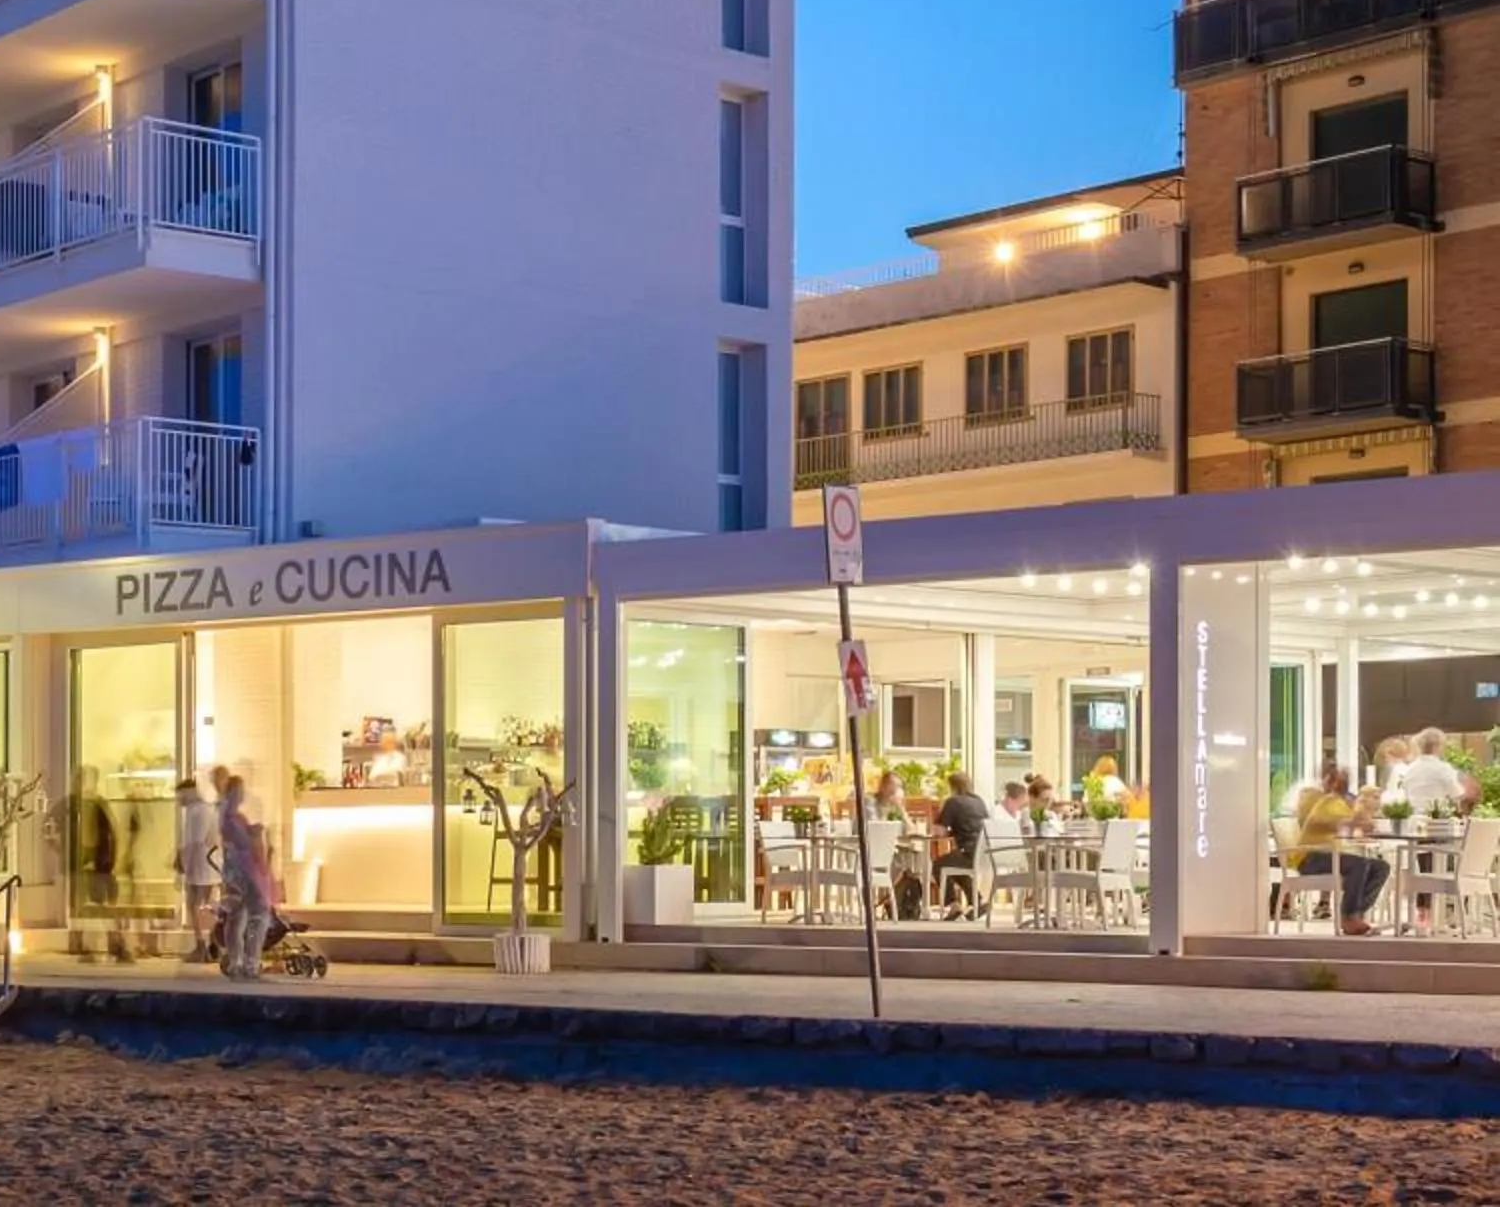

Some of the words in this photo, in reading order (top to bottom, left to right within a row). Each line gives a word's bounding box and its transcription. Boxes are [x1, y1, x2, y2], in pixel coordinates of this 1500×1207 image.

[115, 566, 234, 616] PIZZA
[248, 579, 263, 607] e
[274, 548, 451, 605] CUCINA
